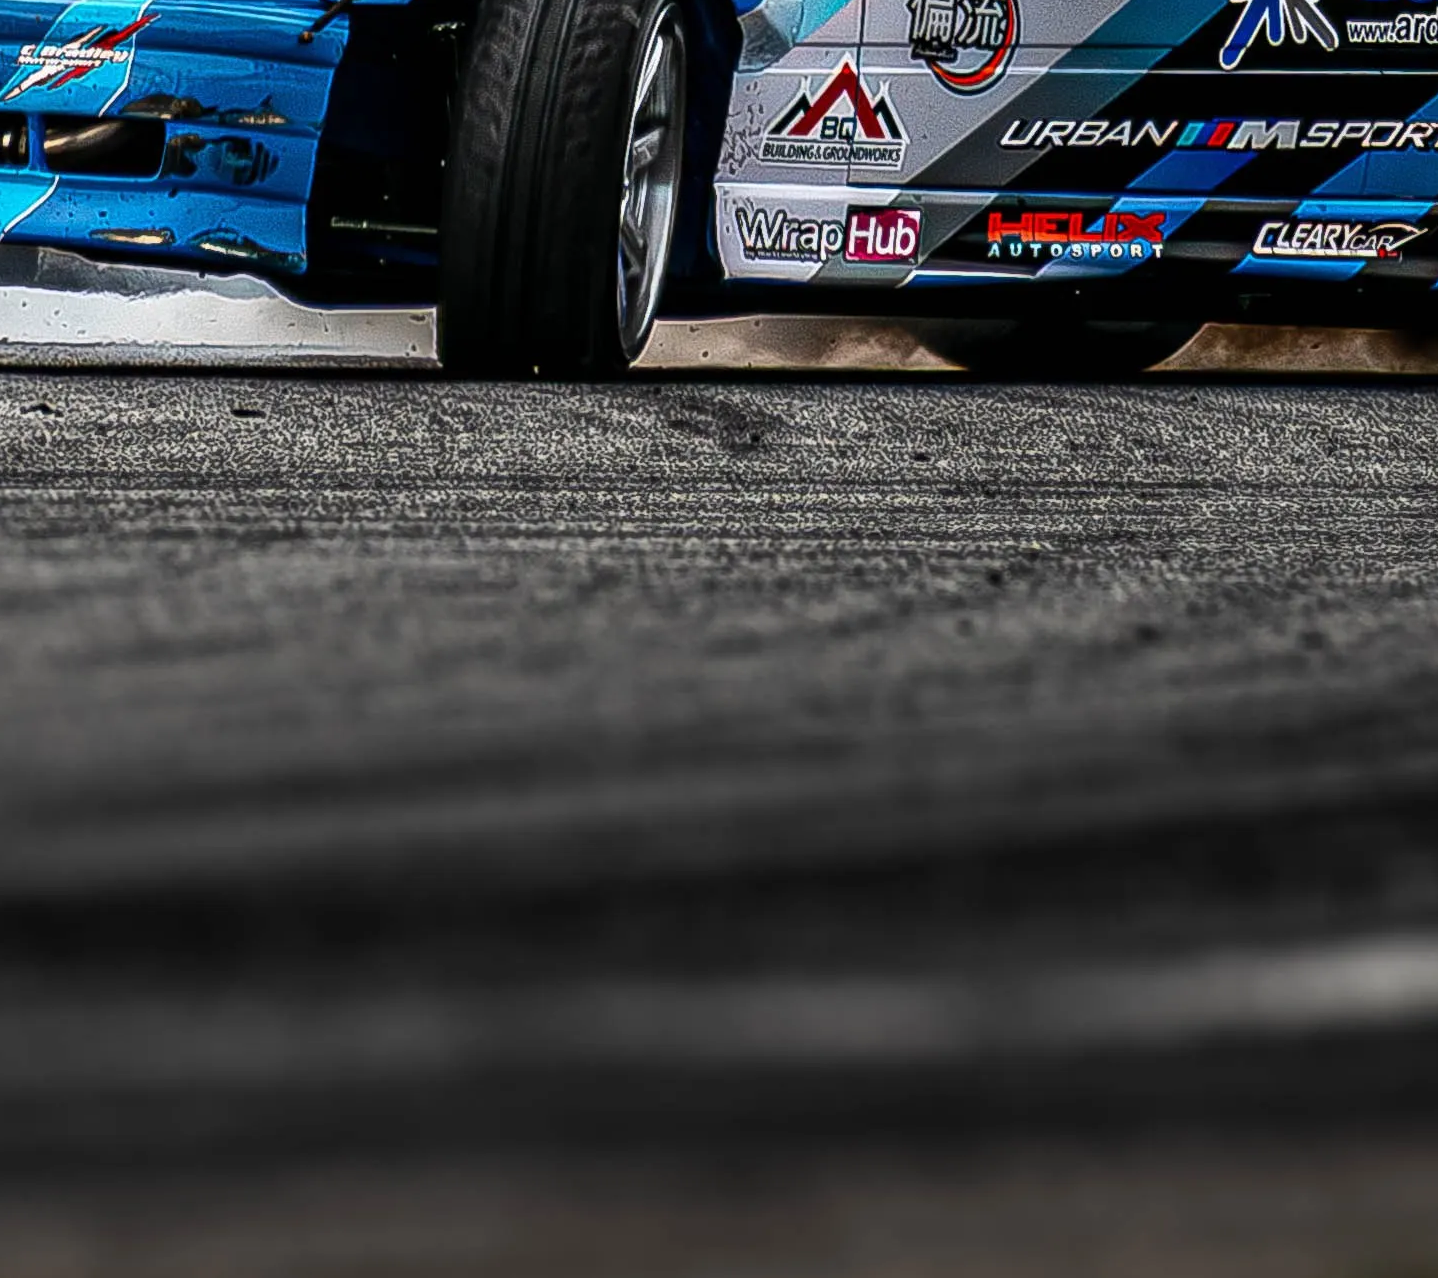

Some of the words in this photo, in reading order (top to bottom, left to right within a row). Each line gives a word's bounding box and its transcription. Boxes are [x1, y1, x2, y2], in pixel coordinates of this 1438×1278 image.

[40, 45, 129, 63] Bradley
[1000, 120, 1178, 147] URBAN
[762, 143, 814, 160] BUILDING
[823, 145, 901, 162] GROUNDWORKS
[986, 212, 1165, 243] HELIX
[1253, 222, 1363, 255] CLEARY
[987, 243, 1165, 258] AUTOSPORT
